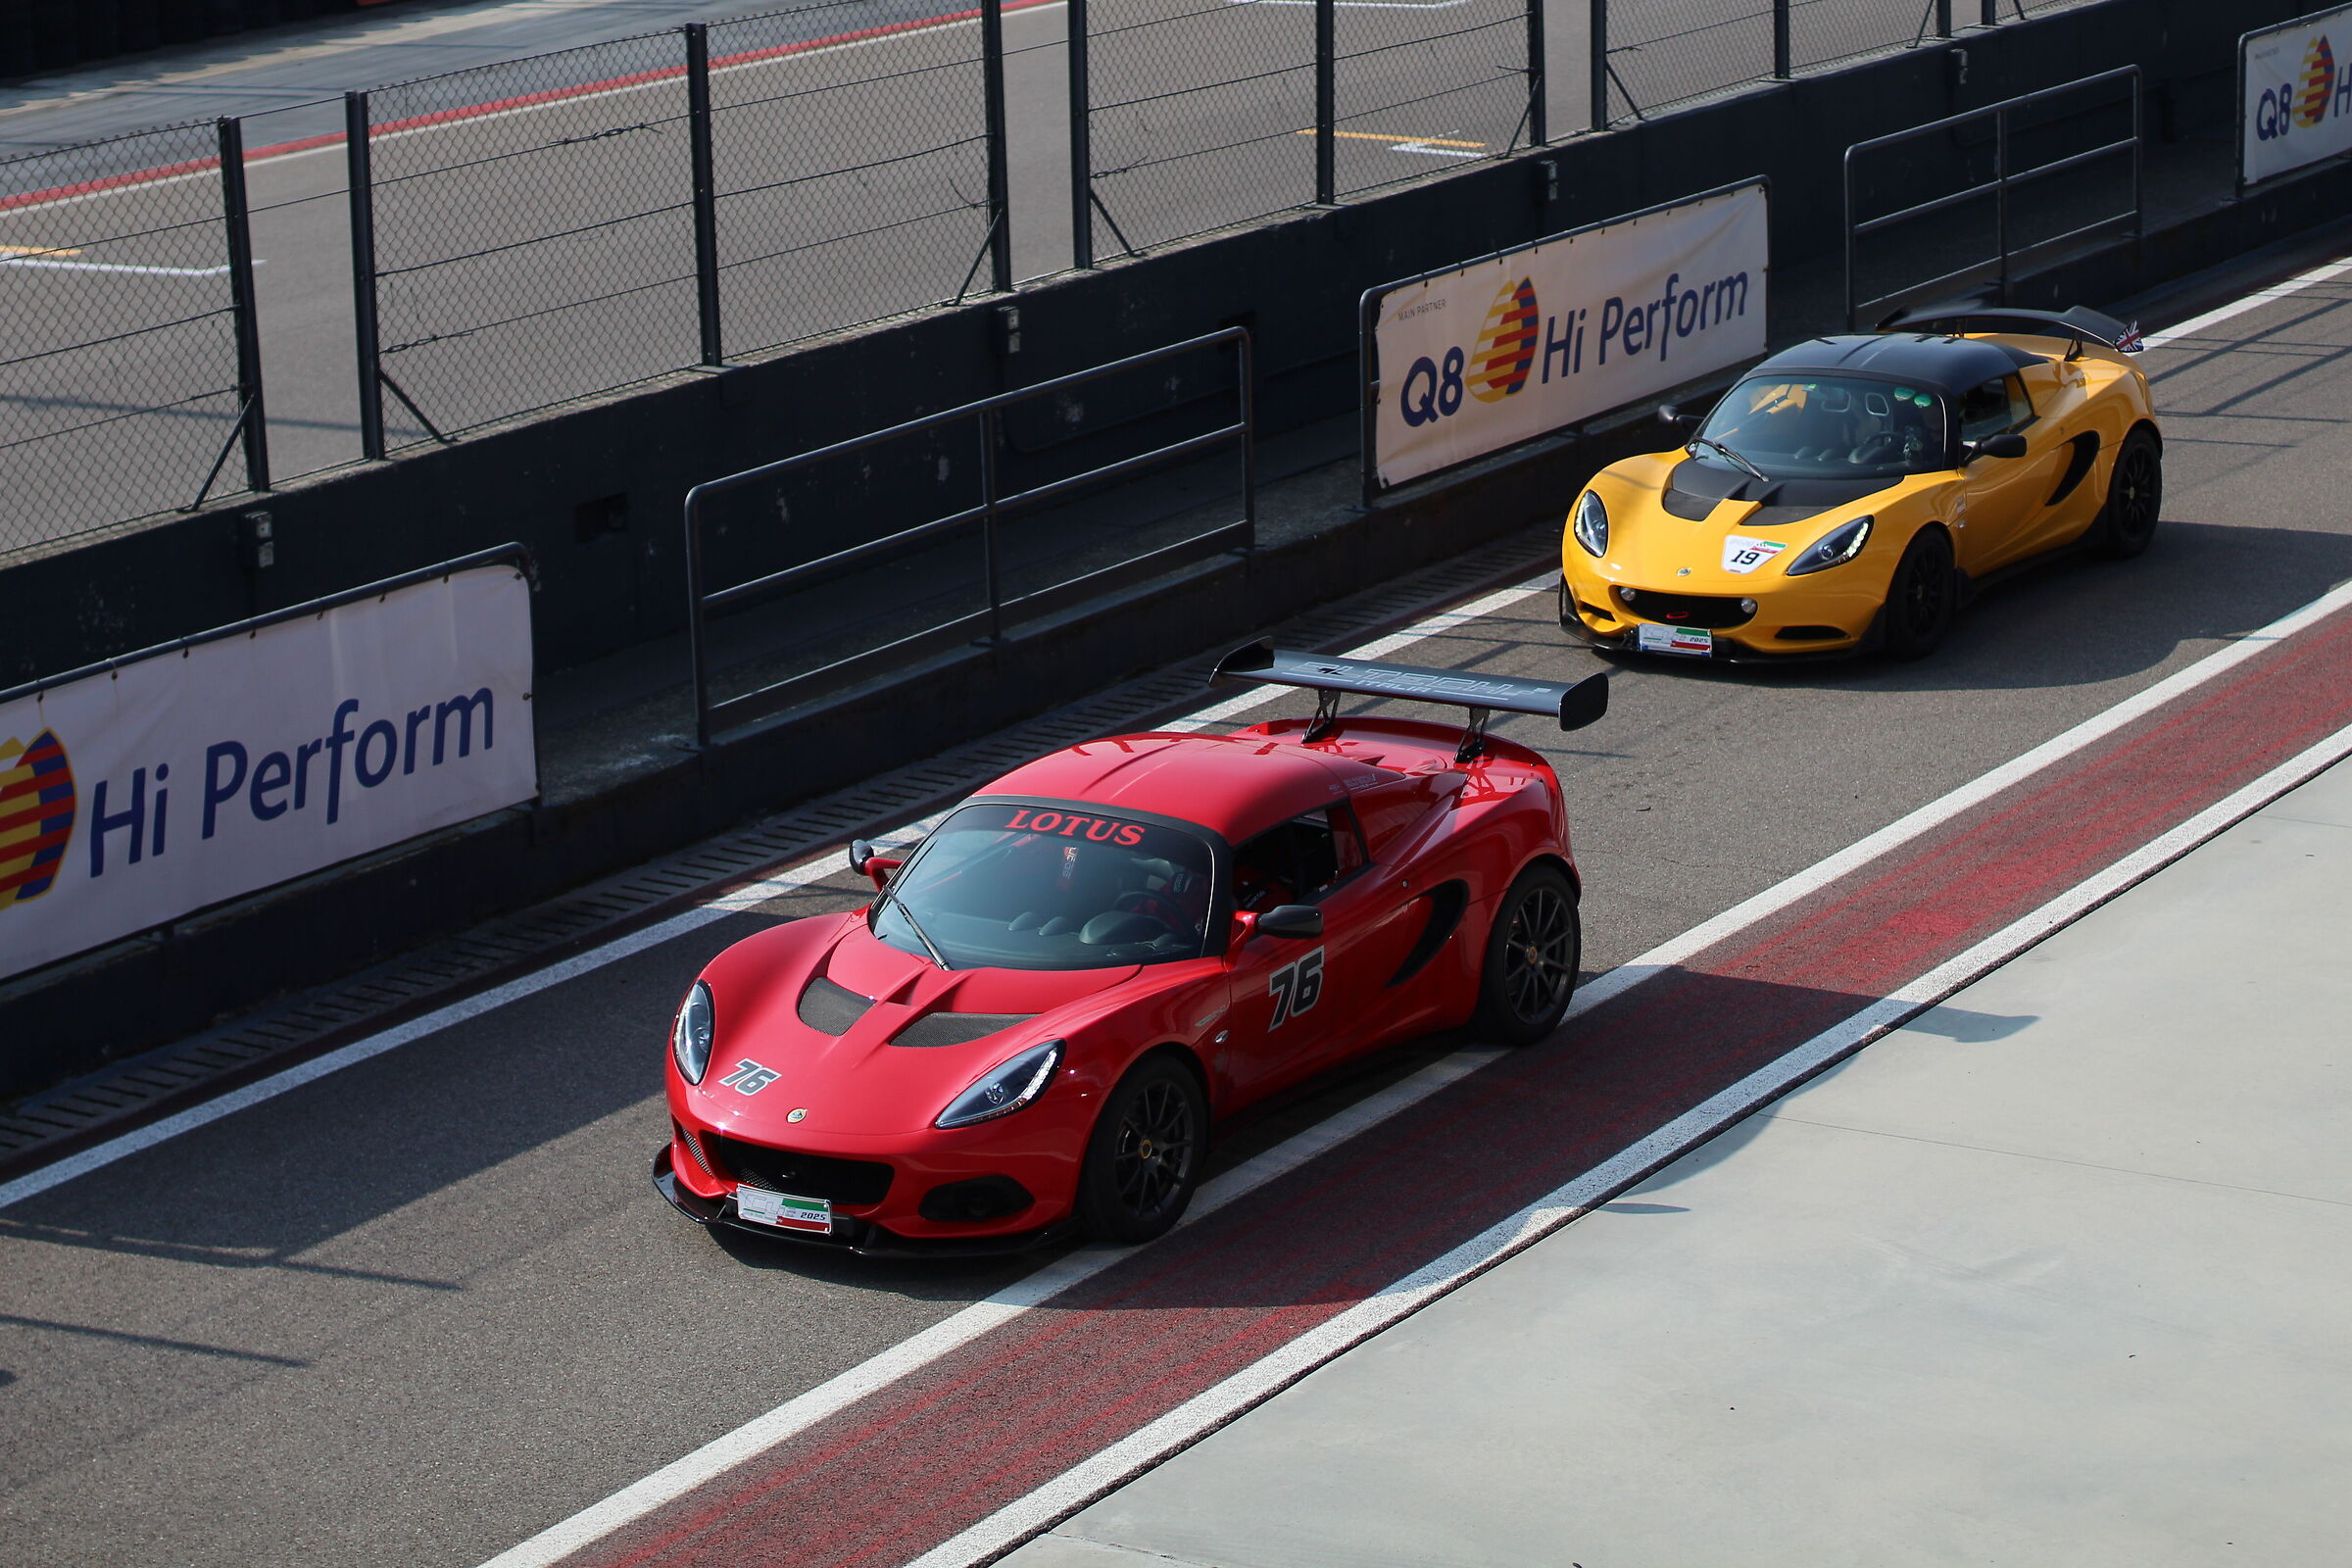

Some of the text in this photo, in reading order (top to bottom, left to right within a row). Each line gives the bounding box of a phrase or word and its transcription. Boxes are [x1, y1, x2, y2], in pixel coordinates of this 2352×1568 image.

[2256, 82, 2293, 141] Q8
[1397, 298, 1447, 321] MAIN PARTNER
[1400, 271, 1748, 427] Q8 Hi Perform
[1731, 550, 1761, 565] 19
[1356, 679, 1432, 693] ITALIA
[89, 687, 494, 879] Hi Perform
[1004, 809, 1146, 846] LOTUS
[1267, 945, 1325, 1034] 76
[717, 1057, 782, 1097] 76
[800, 1211, 826, 1221] 2025
